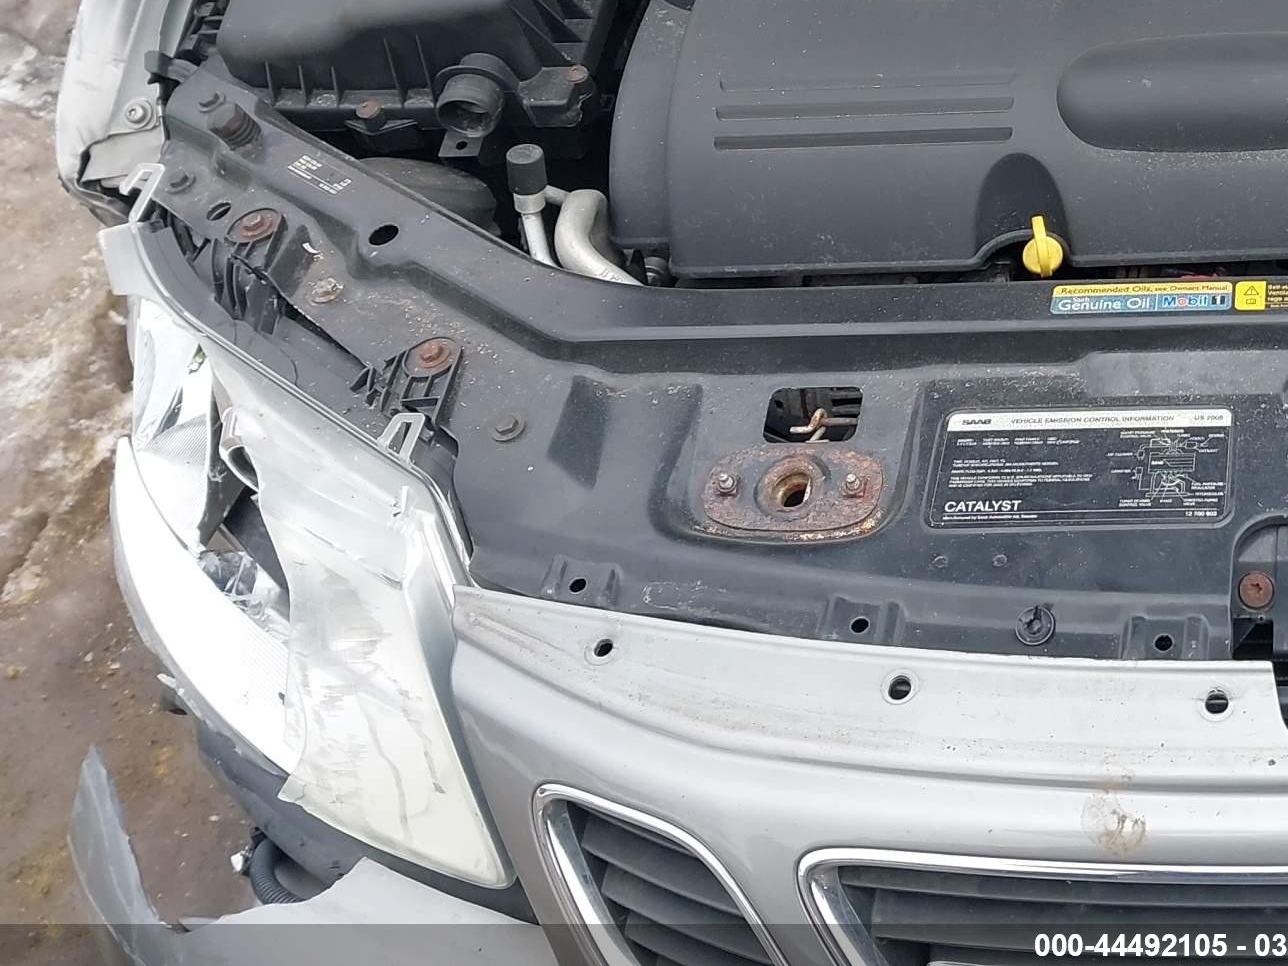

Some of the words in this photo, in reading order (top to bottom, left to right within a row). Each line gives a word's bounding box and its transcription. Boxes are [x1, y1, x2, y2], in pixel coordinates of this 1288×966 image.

[1061, 286, 1129, 295] Recommended
[1132, 285, 1153, 293] Oils,
[1058, 299, 1121, 311] Genuine
[1127, 297, 1150, 308] Oil
[1163, 295, 1208, 307] Mobil
[944, 500, 1022, 513] CATALYST
